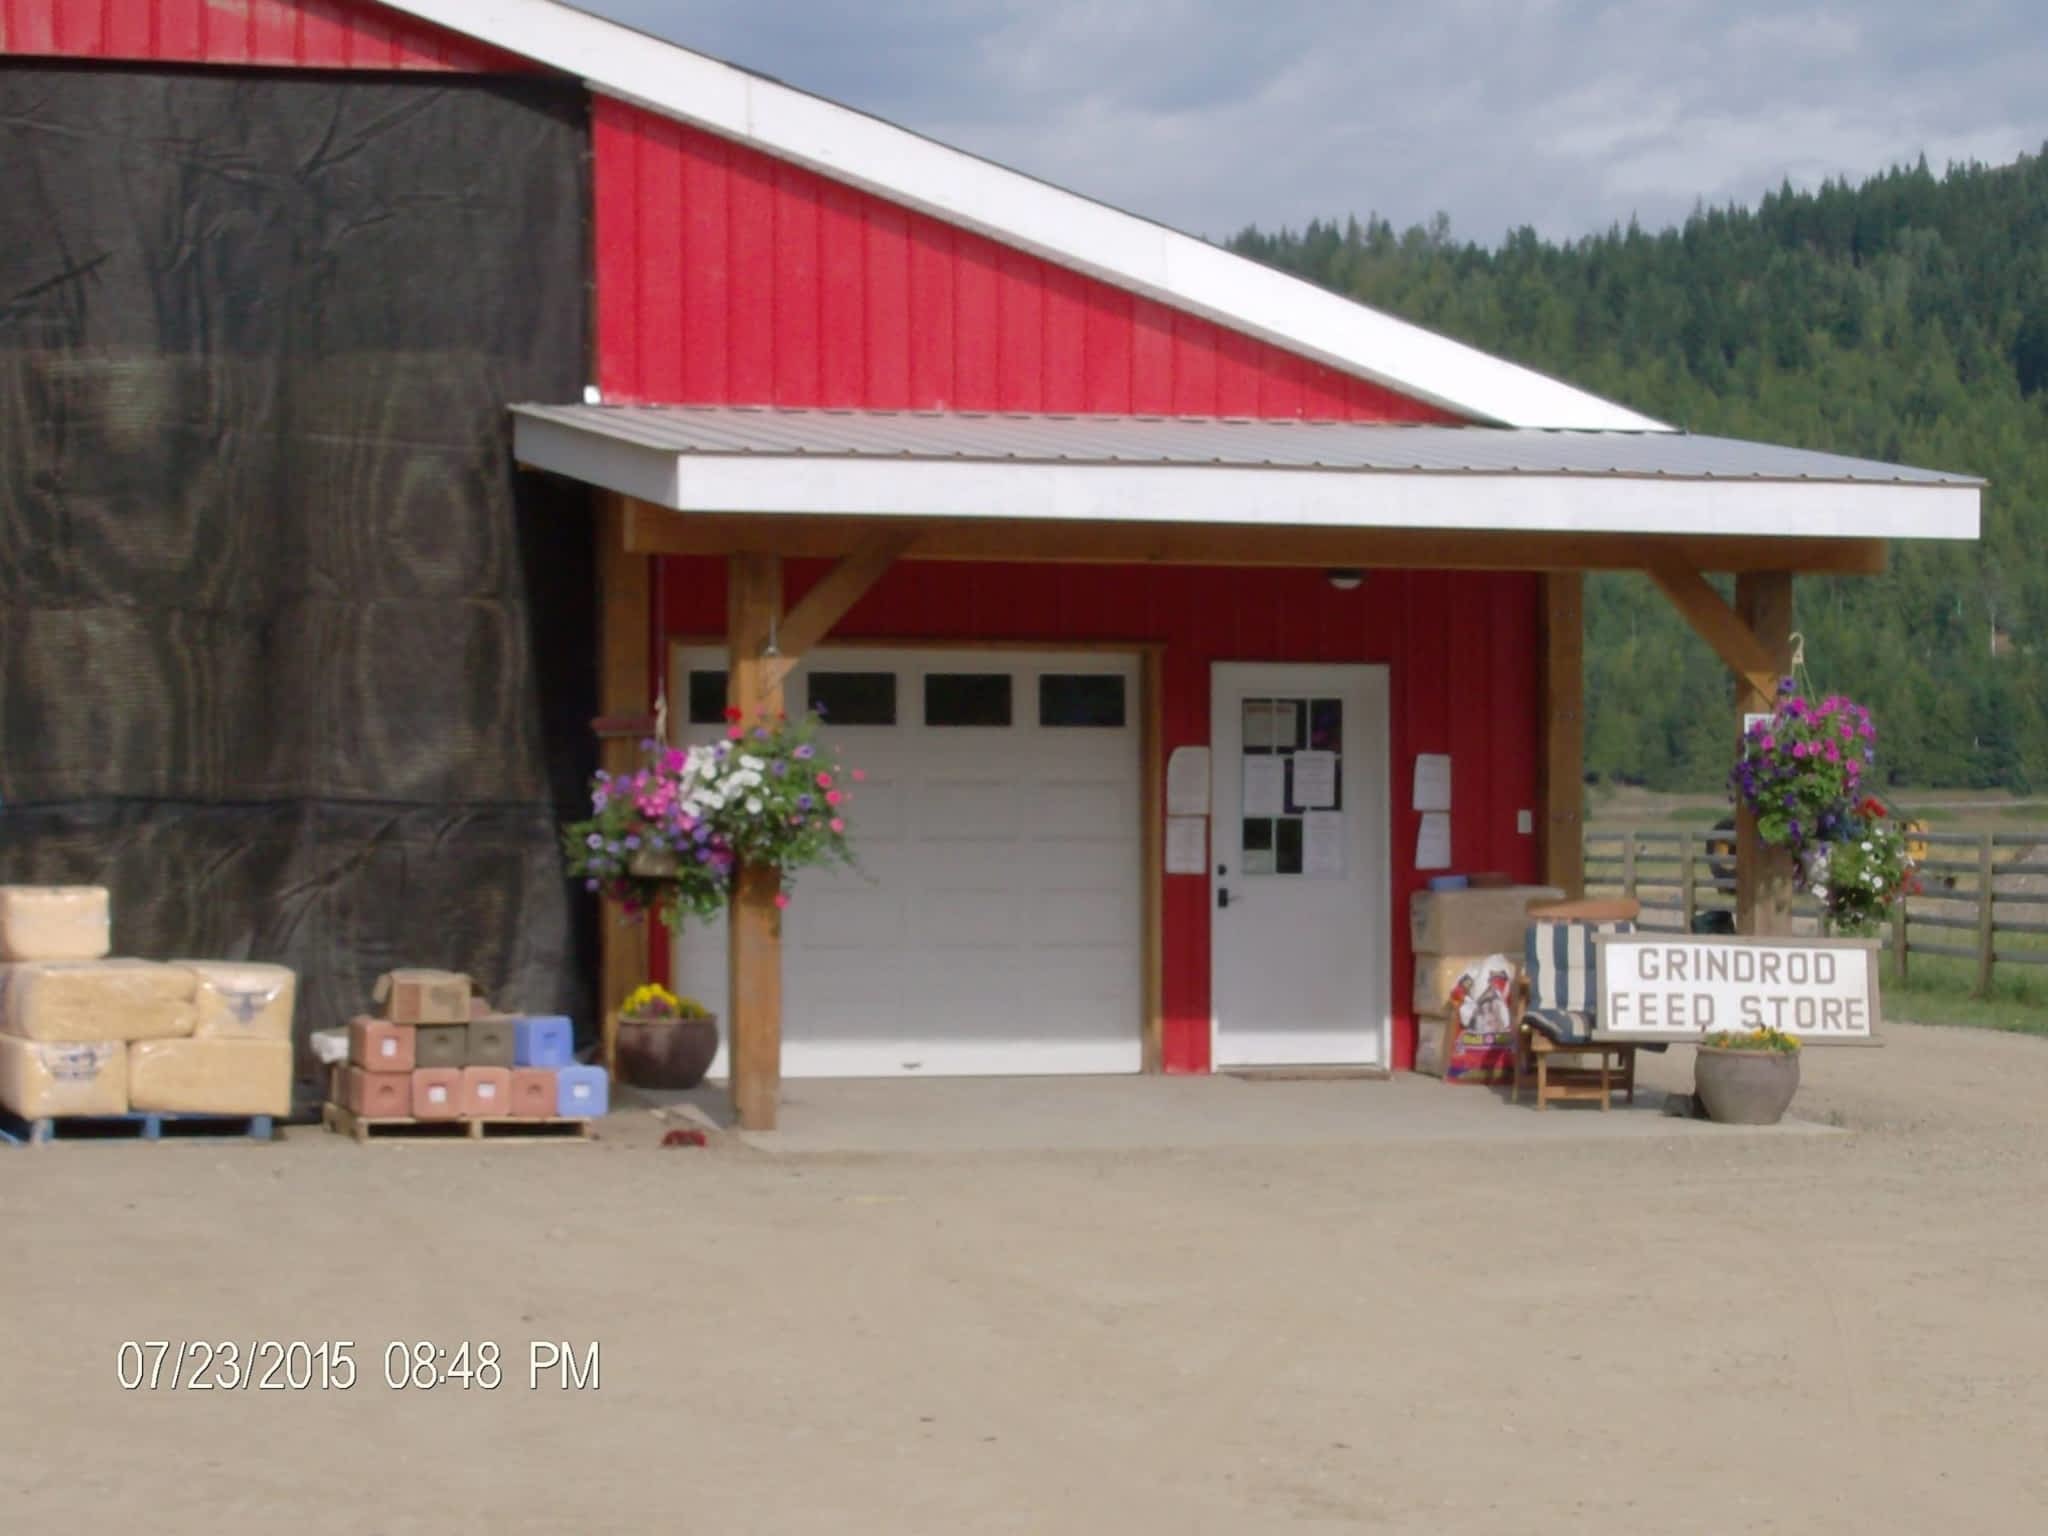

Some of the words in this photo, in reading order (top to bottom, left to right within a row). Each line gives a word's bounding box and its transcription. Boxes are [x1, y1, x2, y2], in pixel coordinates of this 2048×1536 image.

[1638, 948, 1835, 985] GRINDROD
[1611, 992, 1715, 1027] FEED
[1740, 995, 1865, 1030] STORE
